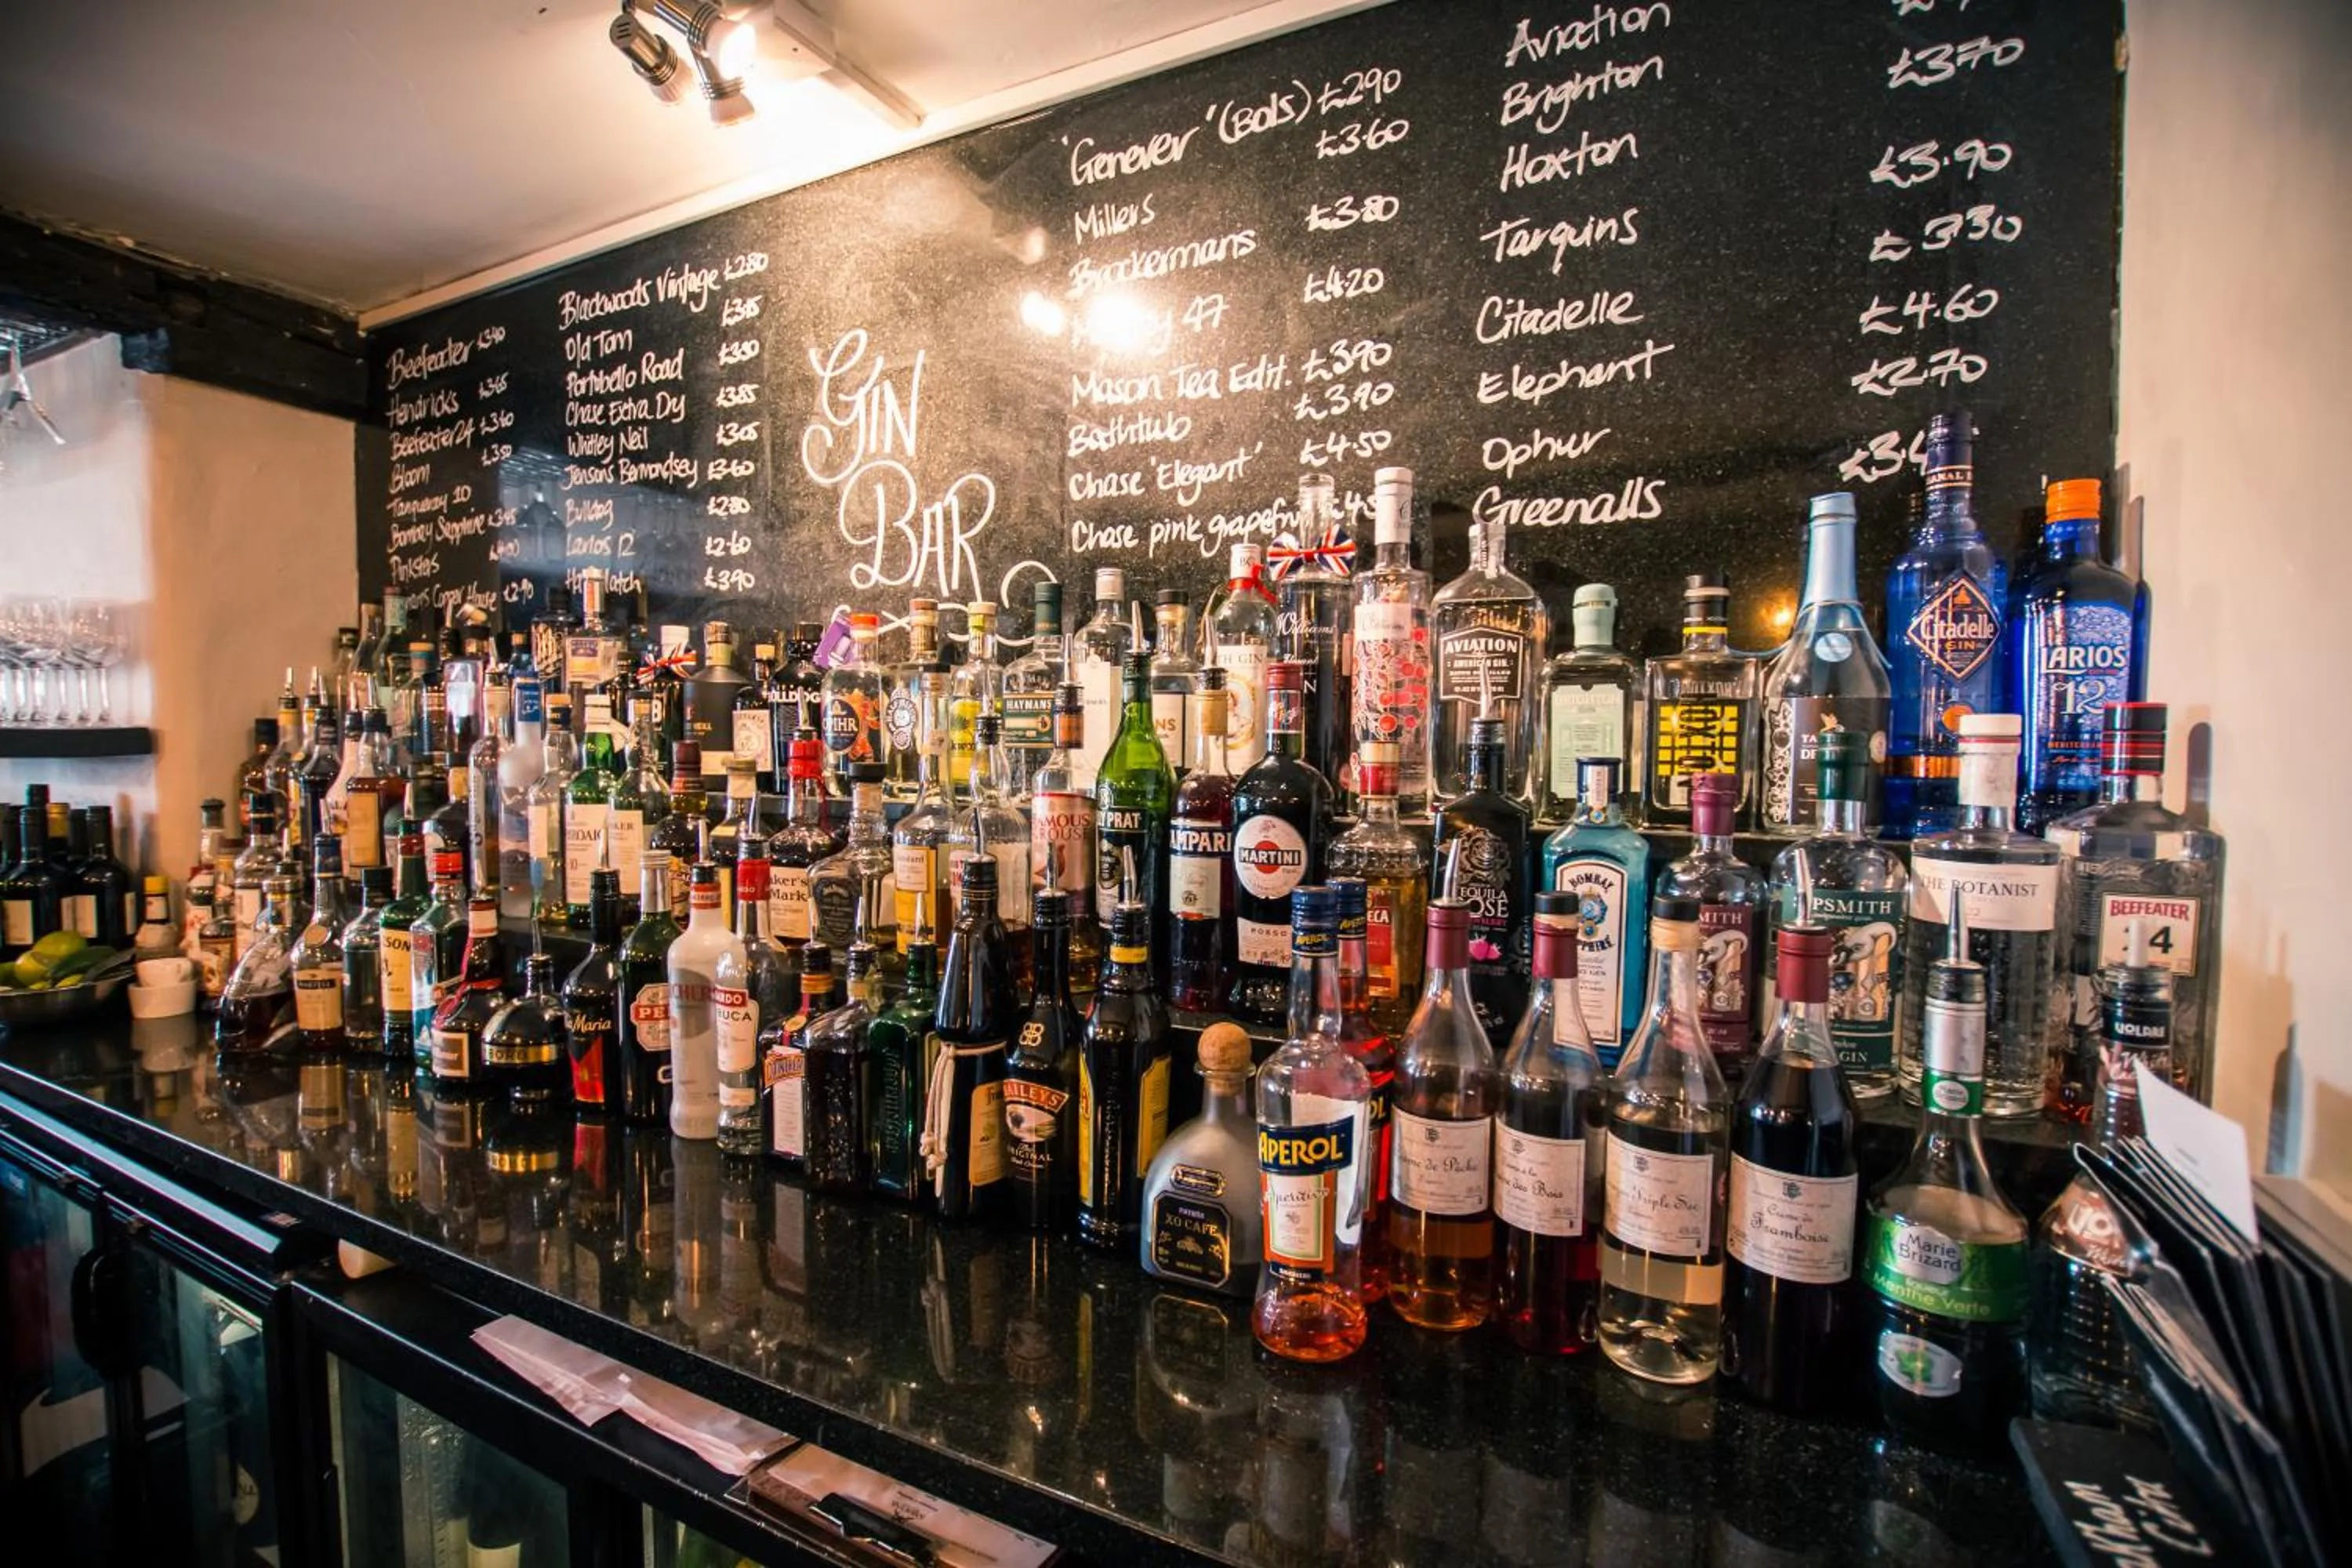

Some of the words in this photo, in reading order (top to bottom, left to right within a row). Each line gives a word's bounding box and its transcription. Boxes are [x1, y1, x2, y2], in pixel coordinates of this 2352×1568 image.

[1504, 2, 1671, 67] Aviation
[1218, 79, 1312, 144] (Bols)
[1501, 55, 1663, 134] Brighton
[1500, 131, 1639, 192] Hoxton
[1869, 140, 2013, 189] £3.90
[1480, 208, 1639, 274] Tarquins
[559, 278, 652, 330] Blackwoods
[657, 263, 720, 313] Vintage
[1183, 293, 1229, 332] 47
[1859, 284, 1998, 334] £4.60
[1477, 292, 1644, 344] Citadelle
[386, 337, 474, 390] Beefeater
[565, 332, 590, 368] Old
[593, 329, 633, 358] Tom
[566, 364, 637, 398] Portobello
[641, 347, 684, 384] Road
[1073, 372, 1163, 407] Mason
[1170, 362, 1222, 400] Tea
[1477, 339, 1675, 405] Elephant
[385, 390, 459, 428] Hendricks
[565, 401, 606, 426] Chase
[609, 397, 654, 426] Extra
[803, 328, 925, 485] GIN
[390, 426, 454, 460] Beefeater
[568, 434, 614, 464] Whitley
[1068, 411, 1192, 458] Bathtub
[1839, 430, 1928, 483] £3.4
[389, 464, 430, 493] Bloom
[1069, 470, 1145, 501] Chase
[565, 499, 613, 531] Bulldog
[1473, 476, 1666, 526] Greenalls
[839, 459, 996, 603] BAR
[1072, 520, 1138, 553] Chase
[1149, 513, 1203, 559] pink
[1920, 614, 1994, 639] Citadelle
[1238, 653, 1265, 666] GIN
[1444, 637, 1517, 654] AVIATION
[2040, 645, 2126, 673] LARIOS
[2053, 680, 2107, 714] 12
[1107, 811, 1142, 829] PRAT
[1240, 849, 1301, 865] MARTINI
[1567, 873, 1615, 894] BOMBAY
[1922, 876, 1947, 891] THE
[1468, 897, 1510, 918] OSE
[1813, 898, 1893, 915] PSMITH
[2110, 899, 2190, 920] BEEFEATER
[573, 1012, 612, 1034] Maria
[1842, 1050, 1869, 1063] GIN
[1004, 1082, 1062, 1107] AILEYS
[1259, 1132, 1343, 1167] APEROL
[1899, 1243, 1962, 1273] Brizard
[1906, 1231, 1957, 1259] Marie
[1873, 1270, 1935, 1308] Menthe
